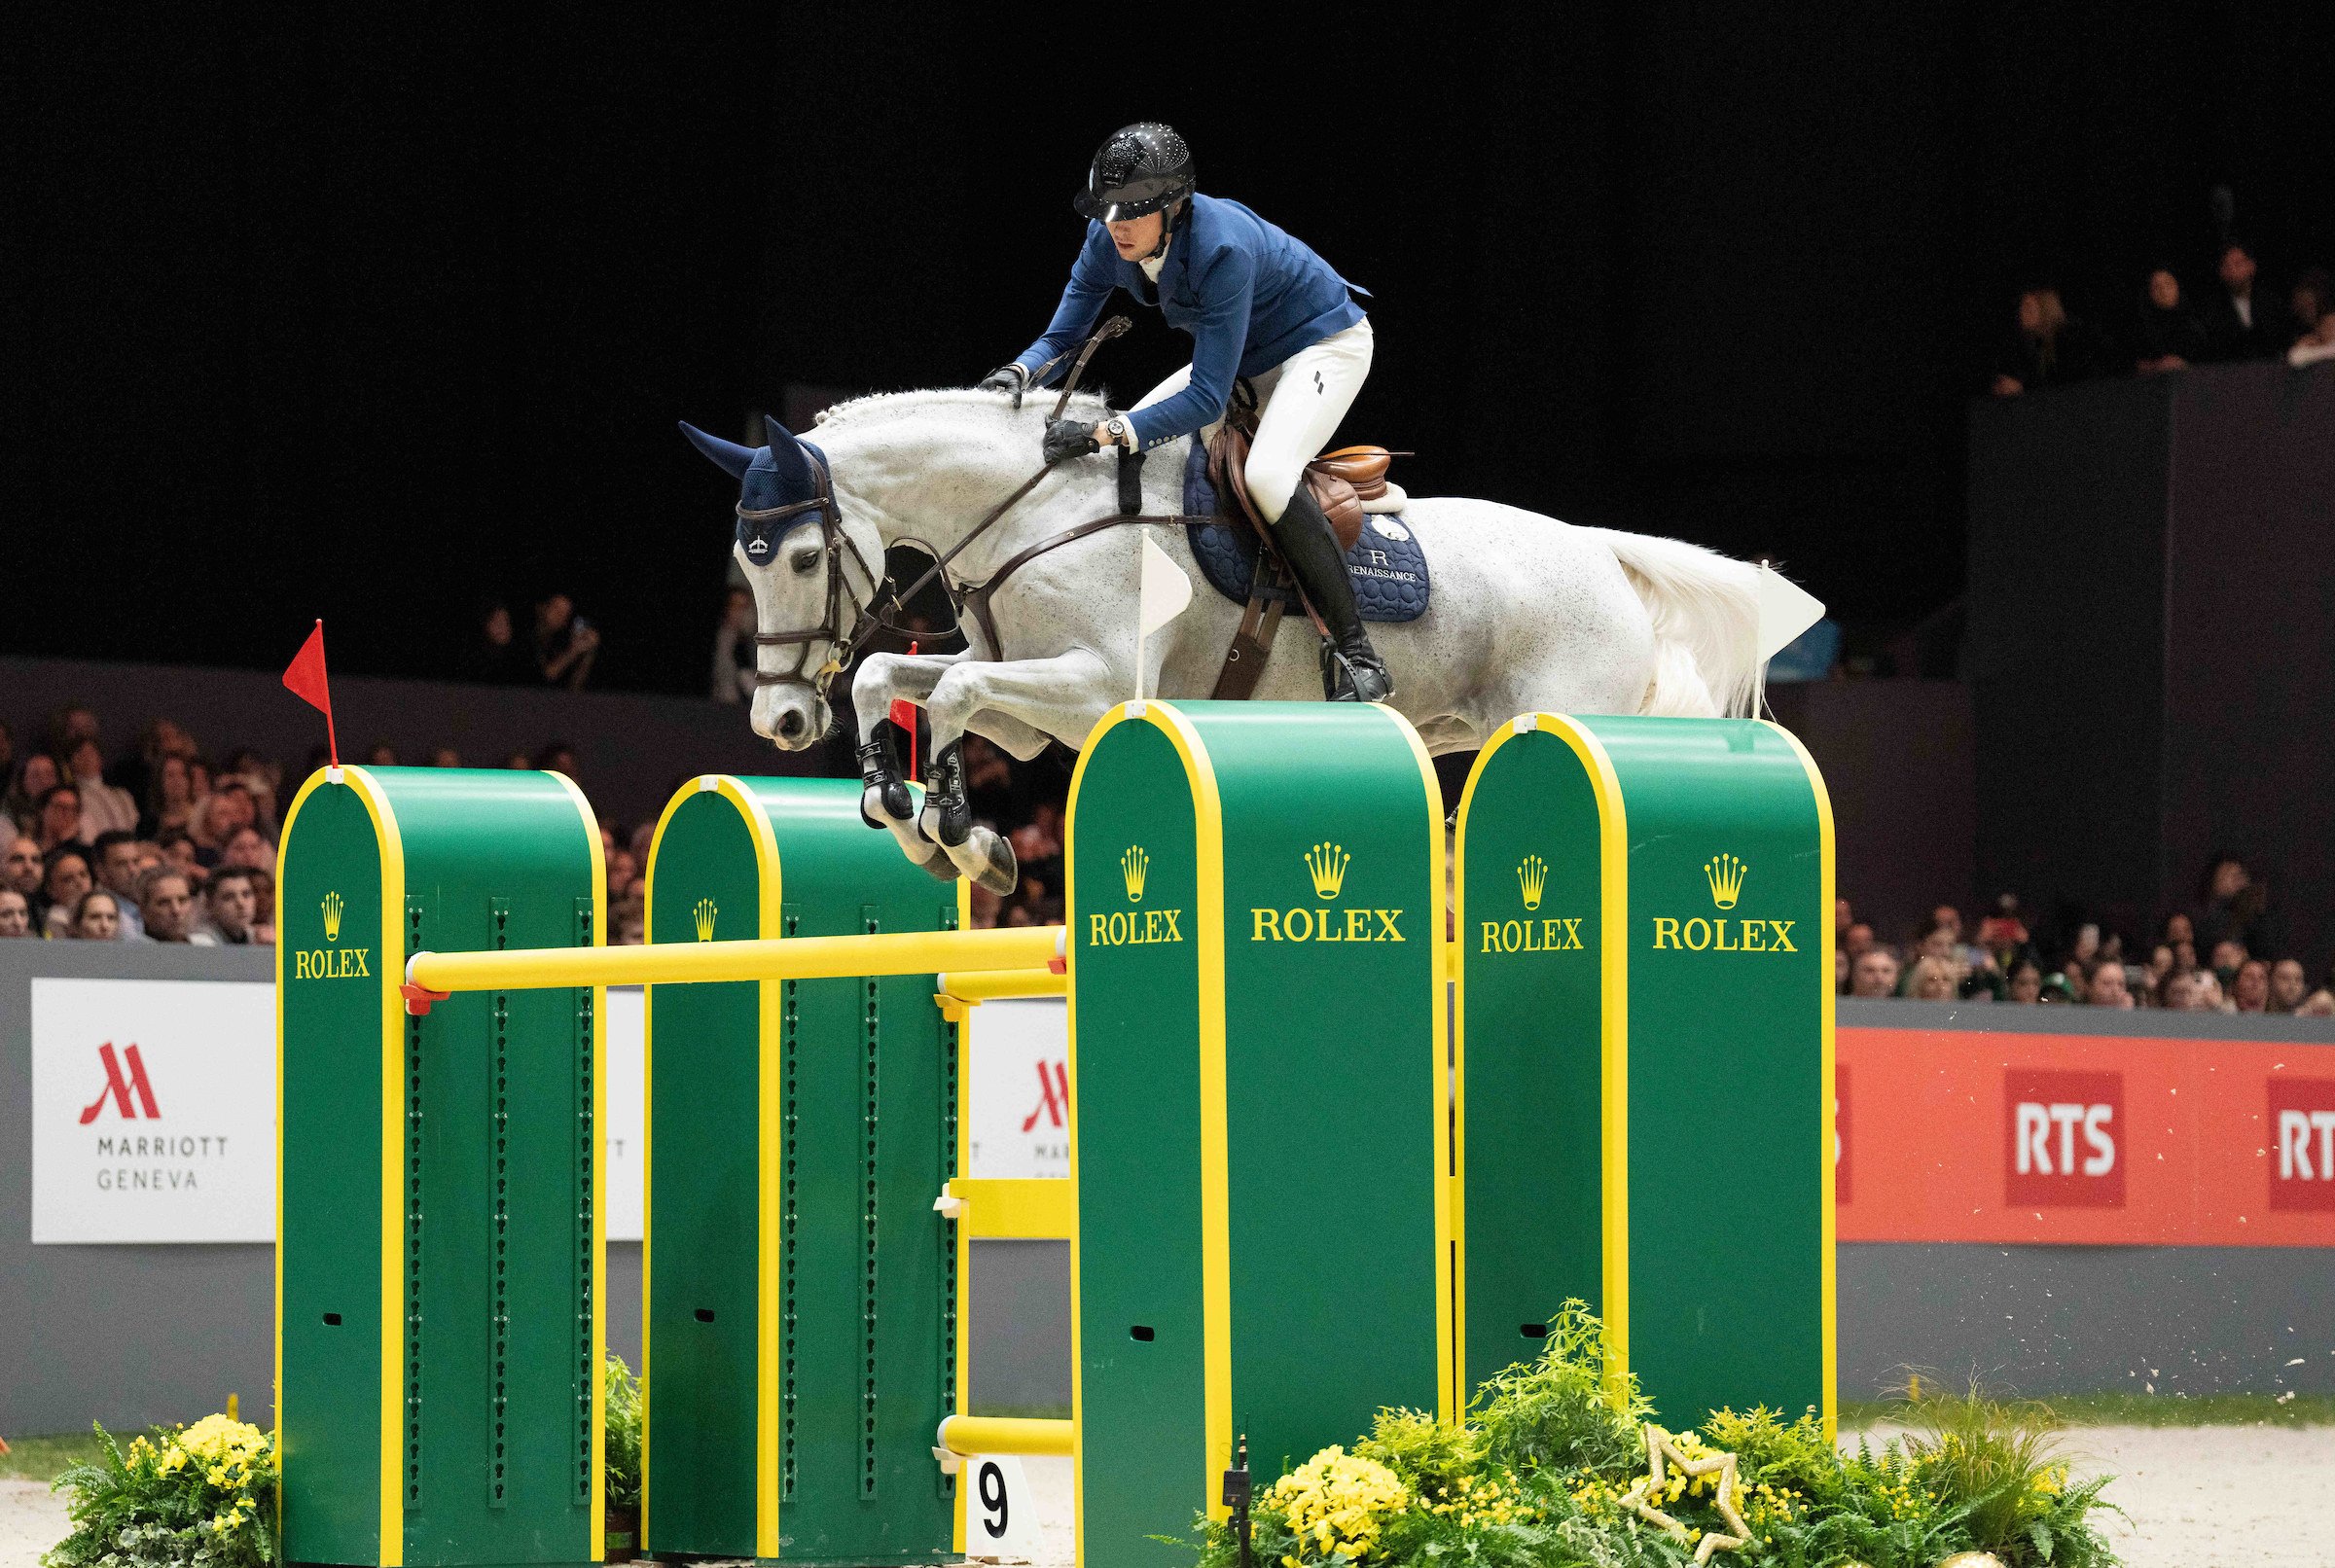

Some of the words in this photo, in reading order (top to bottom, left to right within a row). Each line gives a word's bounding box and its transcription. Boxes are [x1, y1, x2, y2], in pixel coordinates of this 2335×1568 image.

[1370, 550, 1388, 566] R
[1090, 909, 1183, 946] ROLEX
[1251, 909, 1405, 943] ROLEX
[1482, 918, 1584, 952] ROLEX
[1653, 917, 1798, 952] ROLEX
[295, 949, 370, 980] ROLEX
[97, 1136, 229, 1158] MARRIOTT
[2016, 1102, 2115, 1176] RTS
[2280, 1109, 2335, 1181] RT
[97, 1169, 198, 1191] GENEVA
[978, 1461, 1009, 1539] 9
